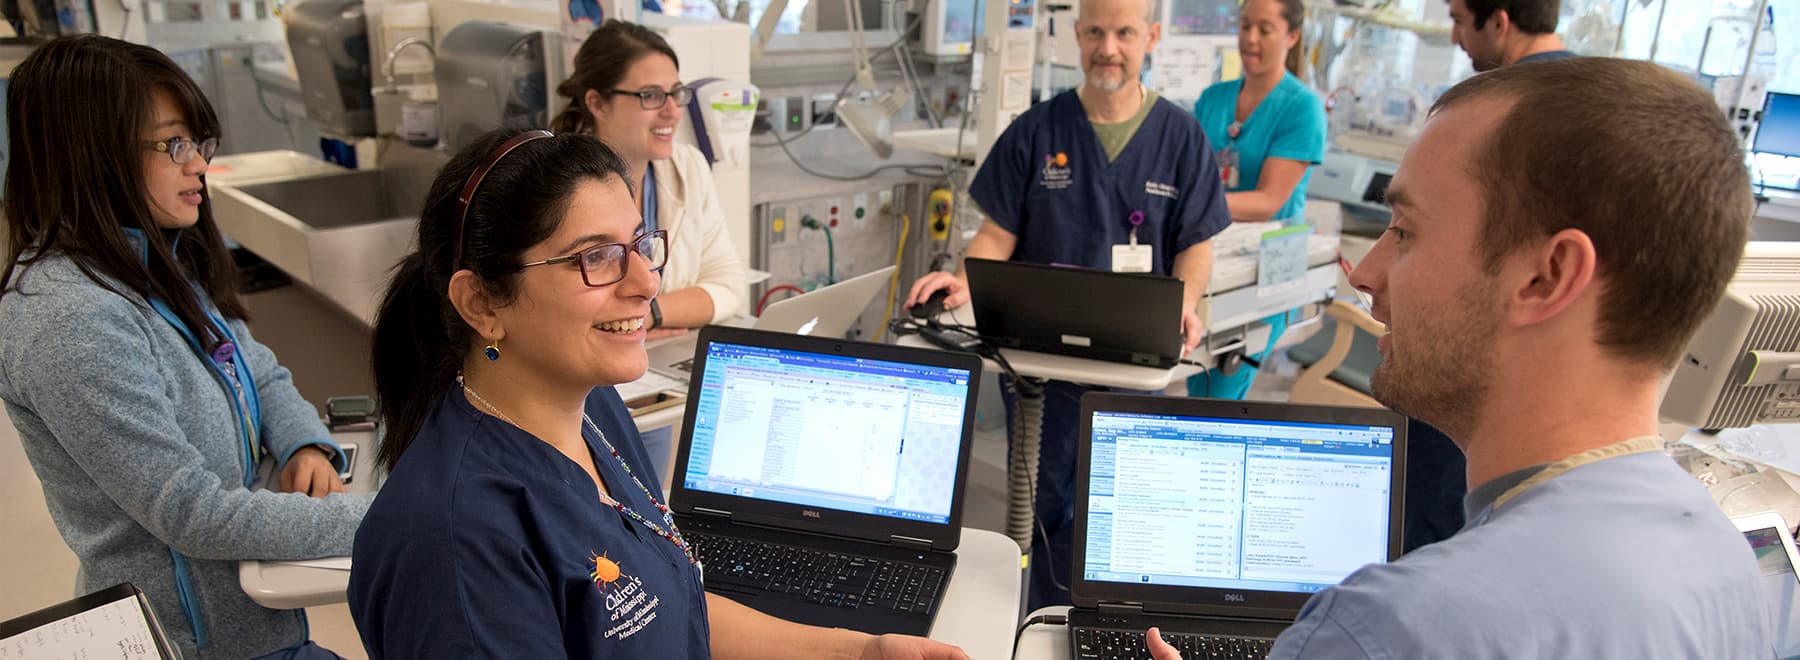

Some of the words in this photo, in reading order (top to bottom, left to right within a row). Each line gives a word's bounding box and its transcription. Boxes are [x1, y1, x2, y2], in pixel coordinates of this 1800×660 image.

[802, 510, 821, 518] DELL
[1224, 593, 1245, 602] DELL
[611, 608, 620, 621] of
[618, 622, 643, 641] Medical
